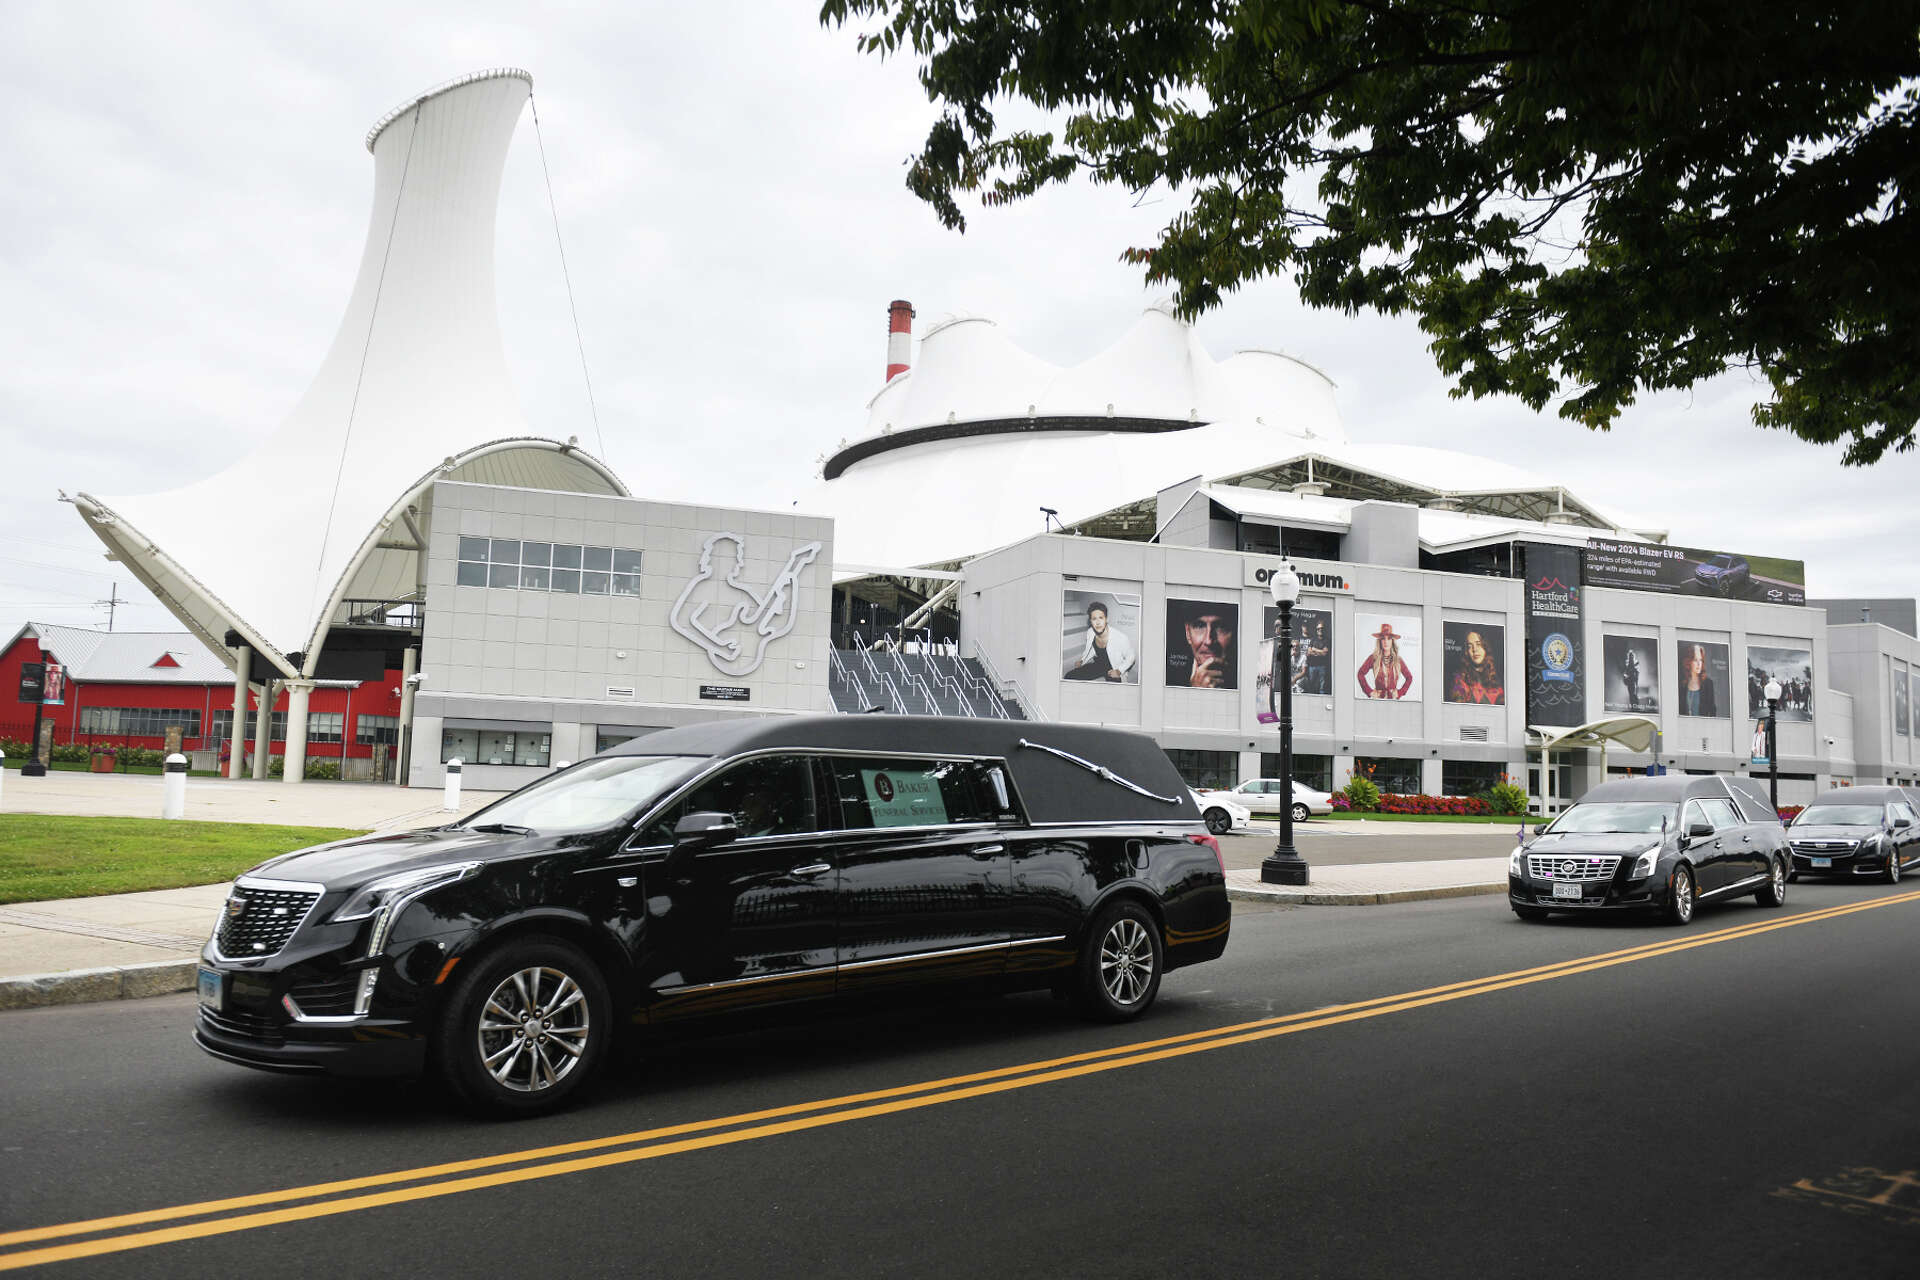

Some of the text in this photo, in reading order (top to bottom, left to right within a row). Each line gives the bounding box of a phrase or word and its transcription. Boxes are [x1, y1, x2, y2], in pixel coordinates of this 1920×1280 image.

[1586, 541, 1685, 560] All-New 2024 Blazer EV RS
[1615, 556, 1621, 564] of
[1531, 590, 1568, 602] Hartford
[1531, 600, 1579, 614] HealthCare
[896, 779, 930, 793] BAKER
[873, 807, 908, 818] FUNERAL
